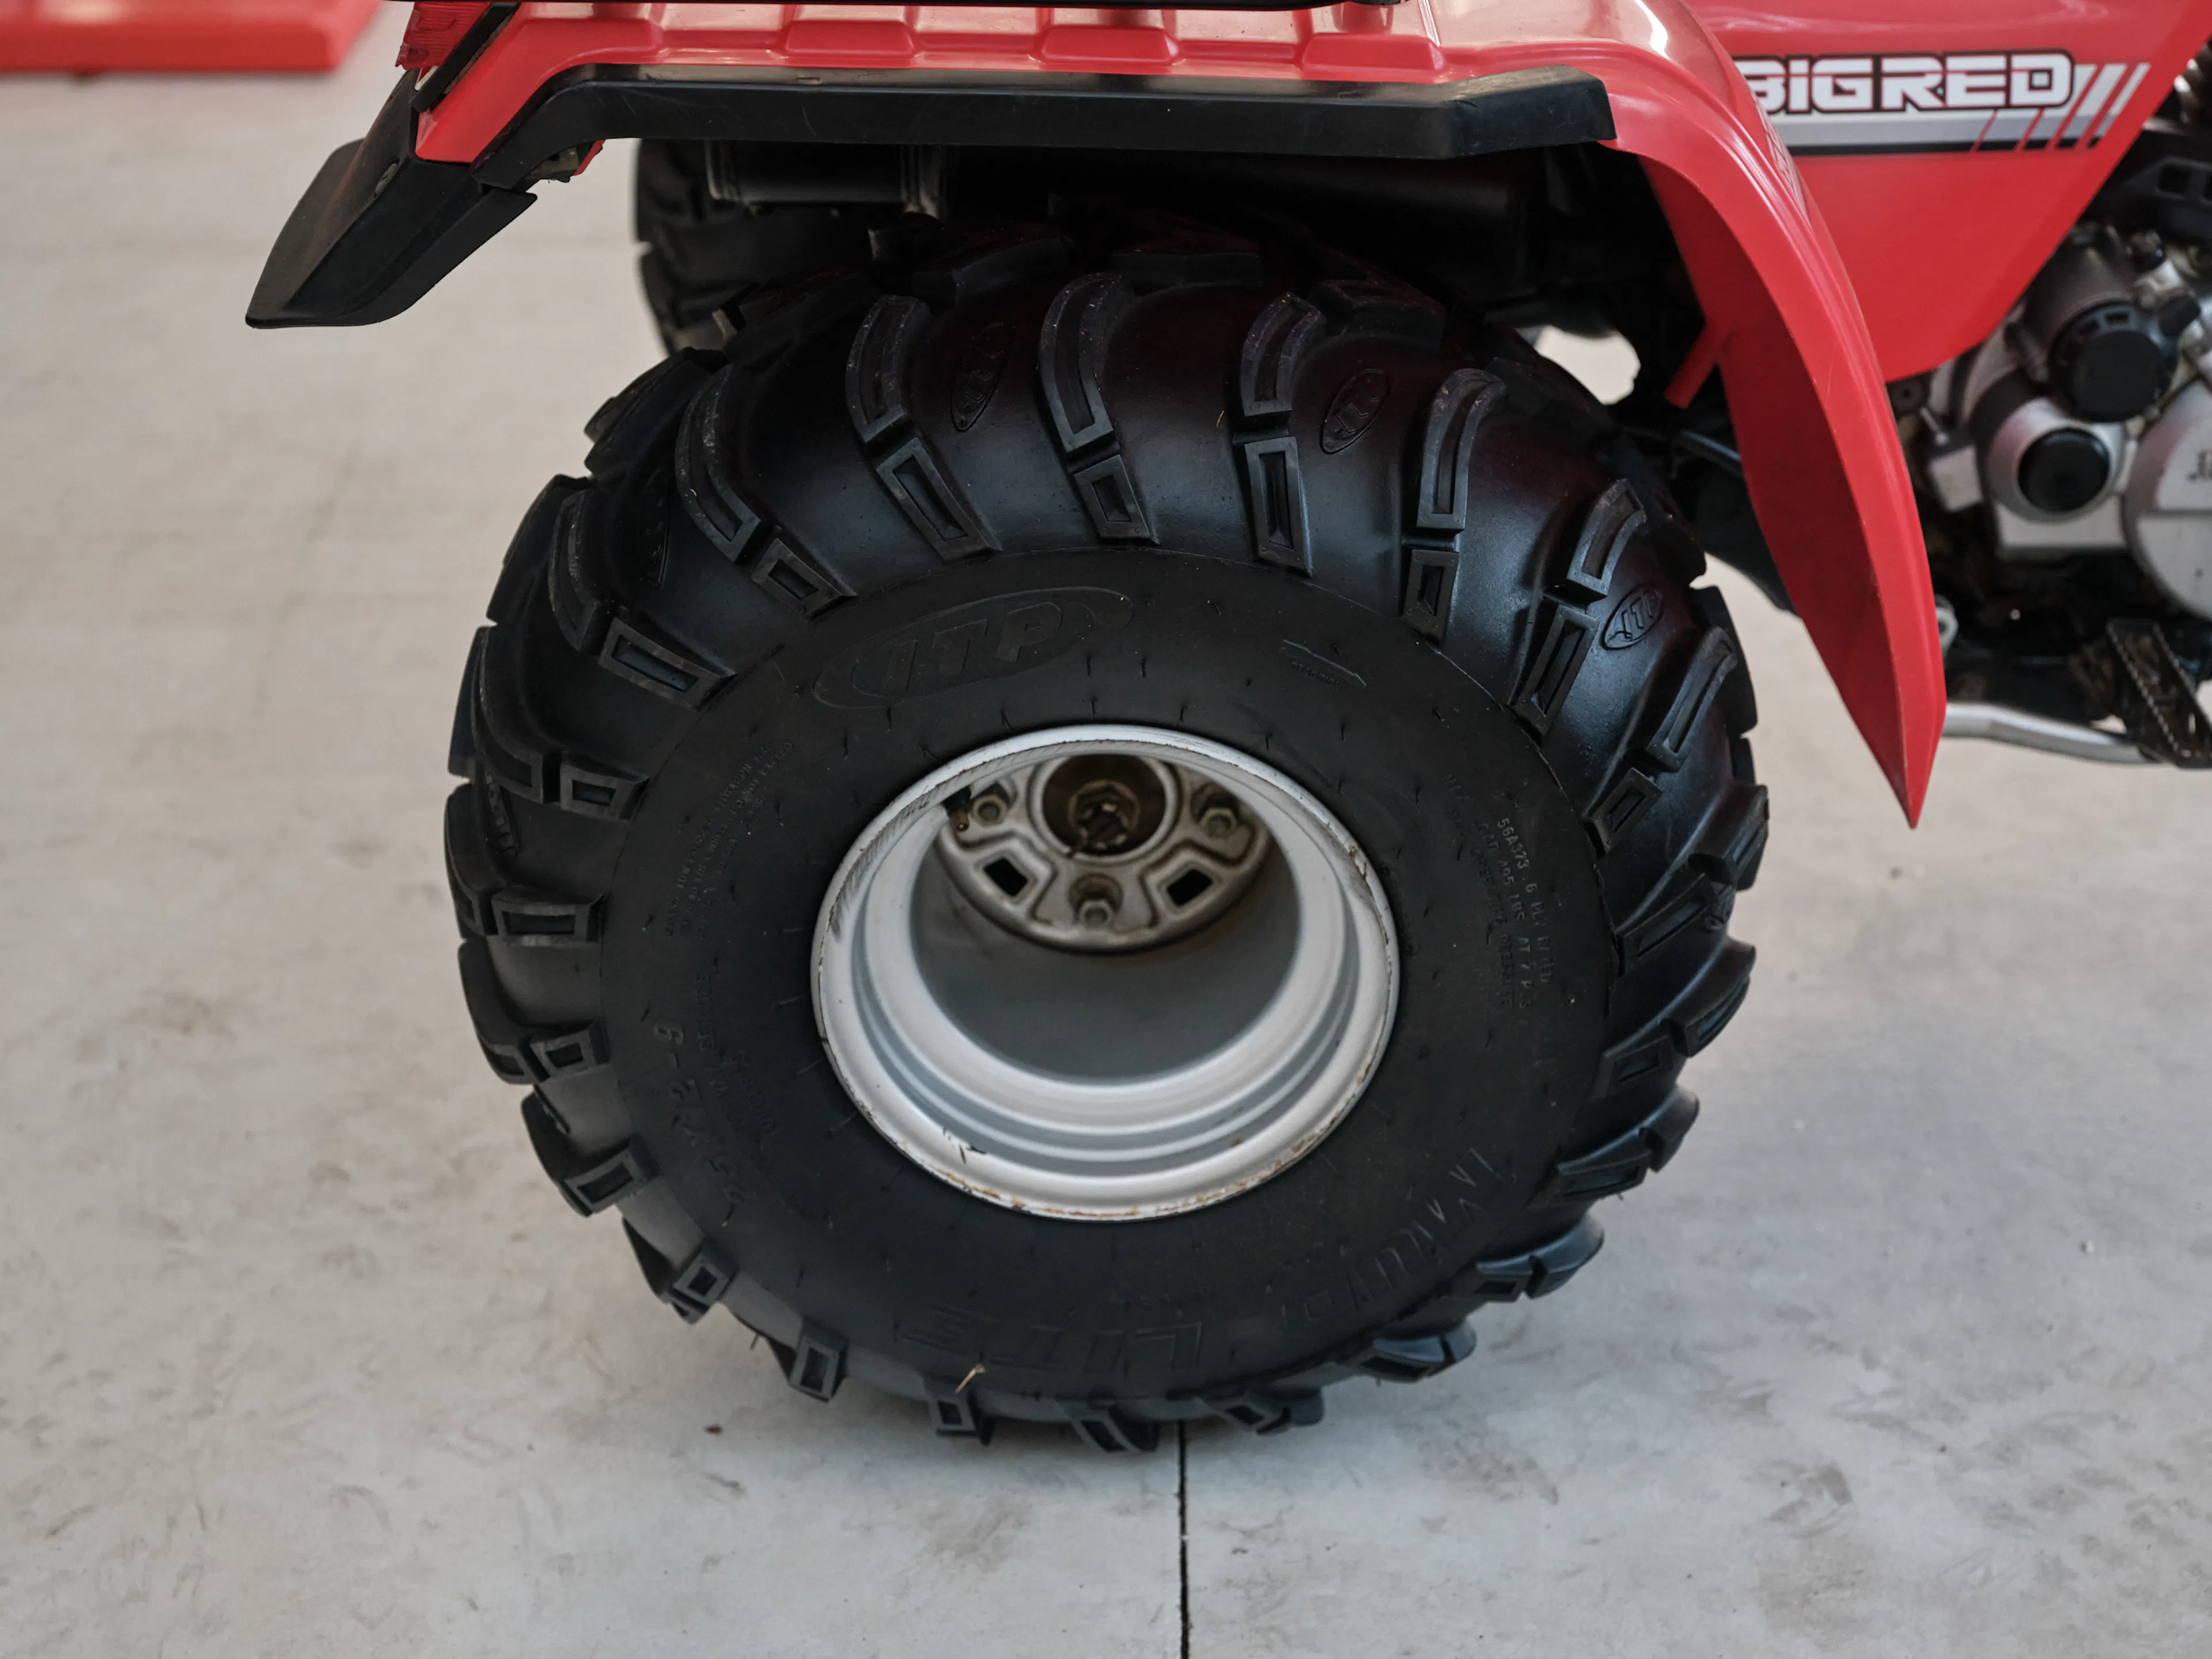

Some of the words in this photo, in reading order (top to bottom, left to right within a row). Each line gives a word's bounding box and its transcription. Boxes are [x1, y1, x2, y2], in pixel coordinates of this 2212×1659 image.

[1730, 55, 1874, 114] BIG
[1878, 50, 2075, 113] RED
[1524, 882, 1539, 893] 6
